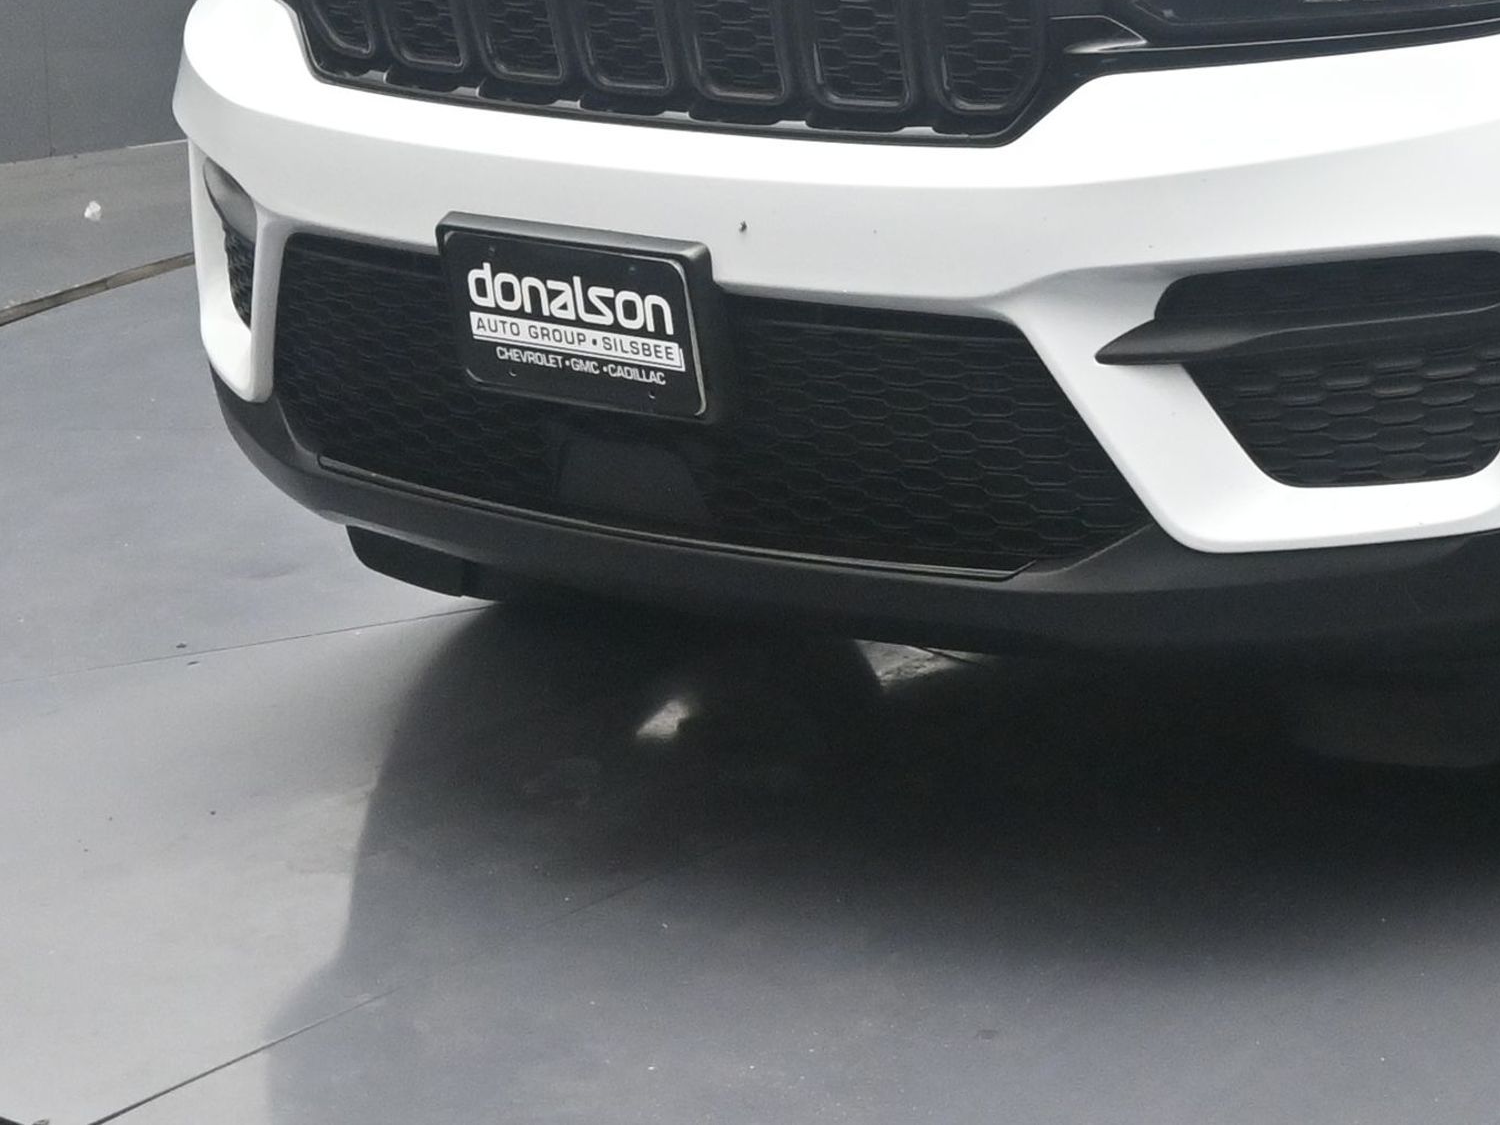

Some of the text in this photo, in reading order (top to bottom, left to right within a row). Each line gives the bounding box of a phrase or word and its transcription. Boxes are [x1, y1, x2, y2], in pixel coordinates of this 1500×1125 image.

[467, 261, 675, 335] donalson
[476, 316, 675, 362] AUTO GROUP SILSBEE
[496, 346, 666, 385] CHEVROLET GMC CADILLAC
